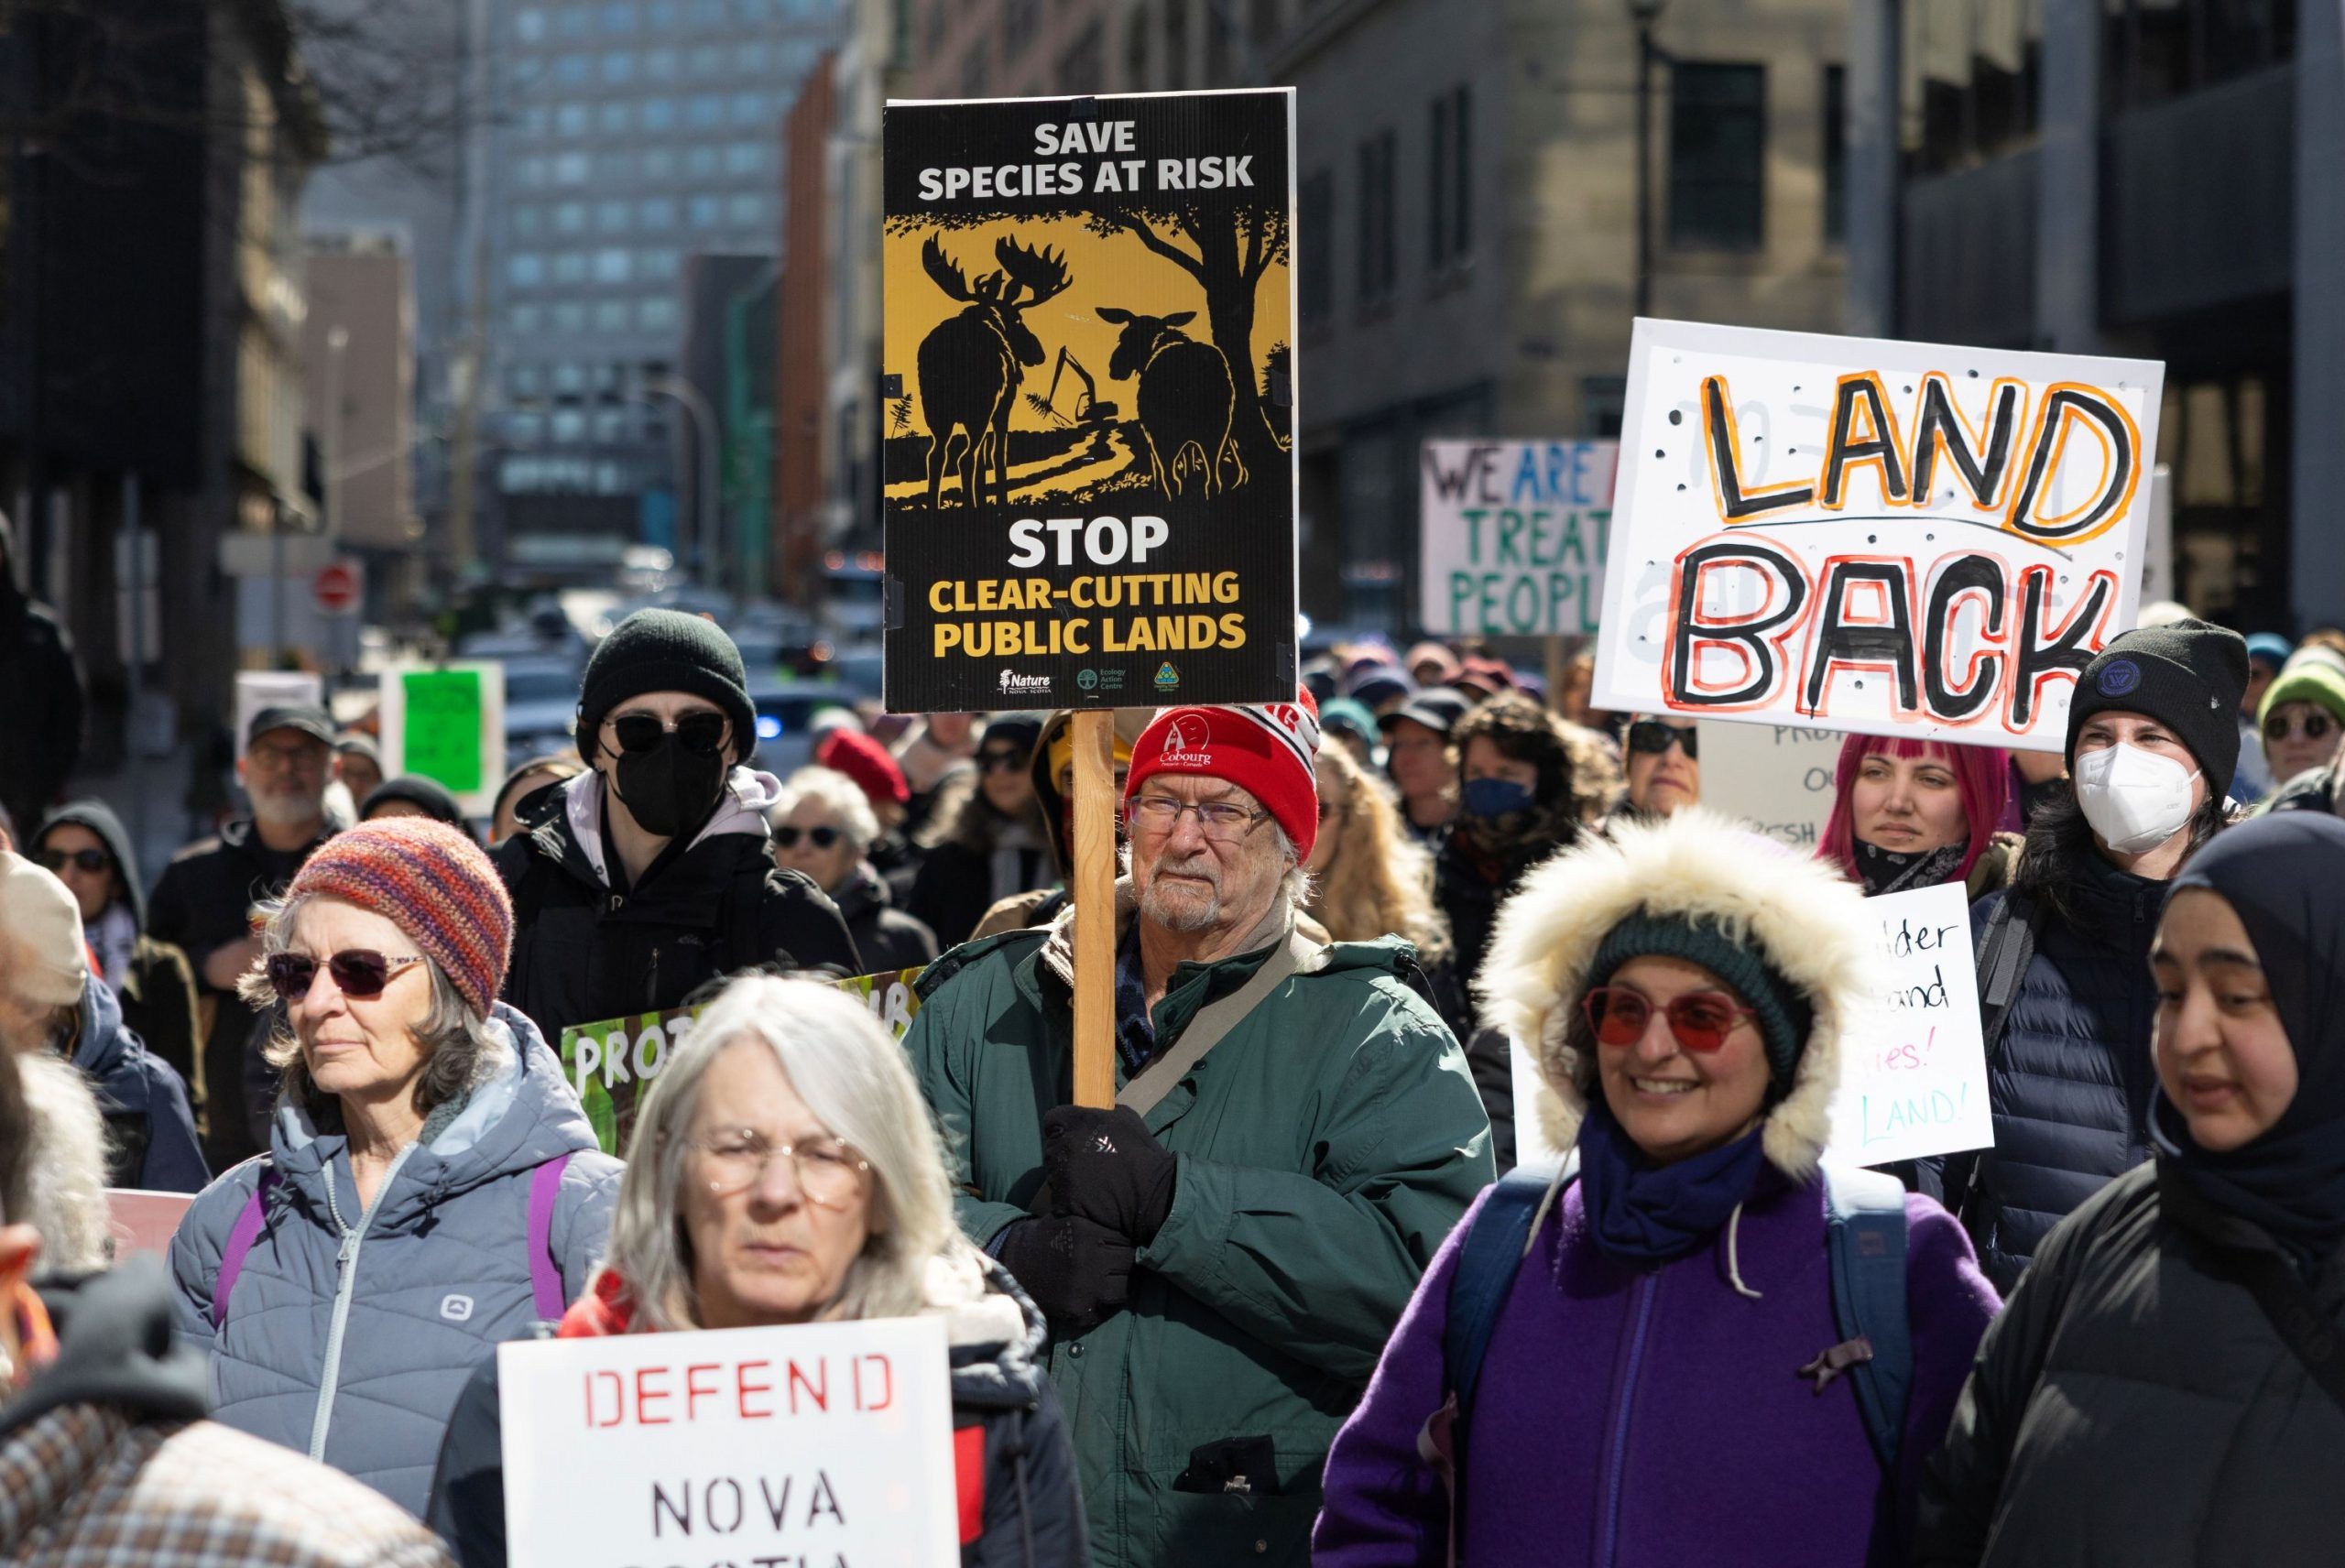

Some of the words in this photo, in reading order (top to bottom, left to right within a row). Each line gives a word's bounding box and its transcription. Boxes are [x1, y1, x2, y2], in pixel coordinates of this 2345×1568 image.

[1034, 120, 1136, 156] SAVE
[918, 162, 1084, 201] SPECIES
[1093, 160, 1146, 193] AT
[1158, 155, 1255, 191] RISK
[1421, 444, 1503, 503] WE
[1512, 441, 1594, 504] ARE
[1701, 369, 2142, 547] LAND
[1008, 516, 1169, 569] STOP
[929, 571, 1239, 613] CLEAR-CUTTING
[934, 618, 1090, 658] PUBLIC
[1103, 613, 1247, 652] LANDS
[1662, 532, 2120, 734] BACK
[1011, 673, 1051, 687] Nature
[1100, 669, 1126, 678] Ecology
[1160, 750, 1211, 765] Cobourg
[1862, 1082, 1967, 1148] LAND!
[584, 1354, 893, 1429] DEFEND
[653, 1469, 845, 1538] NOVA
